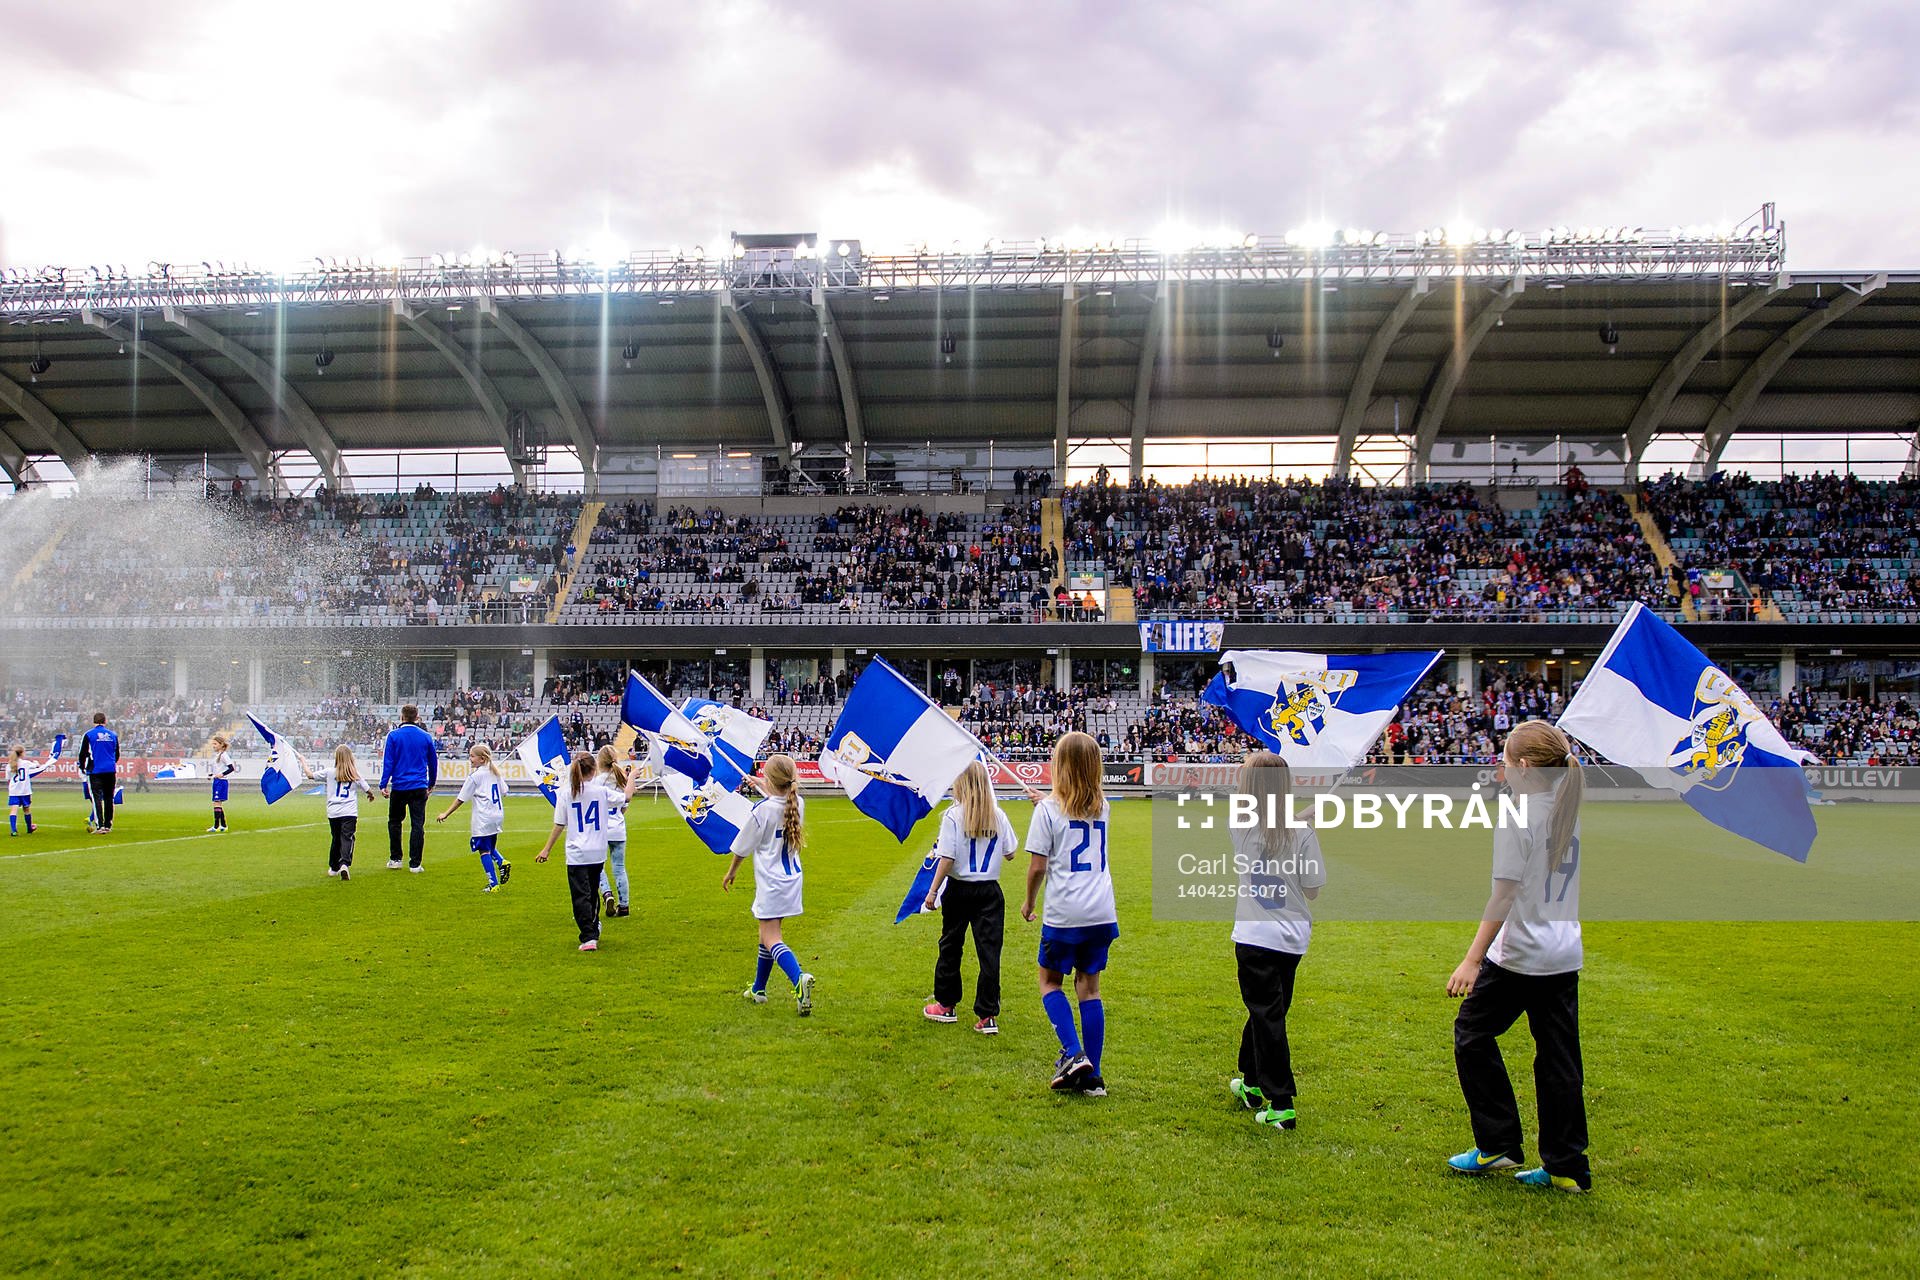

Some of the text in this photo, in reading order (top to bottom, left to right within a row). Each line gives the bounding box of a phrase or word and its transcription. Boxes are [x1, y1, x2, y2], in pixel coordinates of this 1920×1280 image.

[1102, 774, 1128, 783] KUMHO
[1823, 770, 1901, 787] ULLEVI
[491, 783, 502, 810] 4
[571, 800, 601, 833] 14
[1069, 819, 1106, 873] 21
